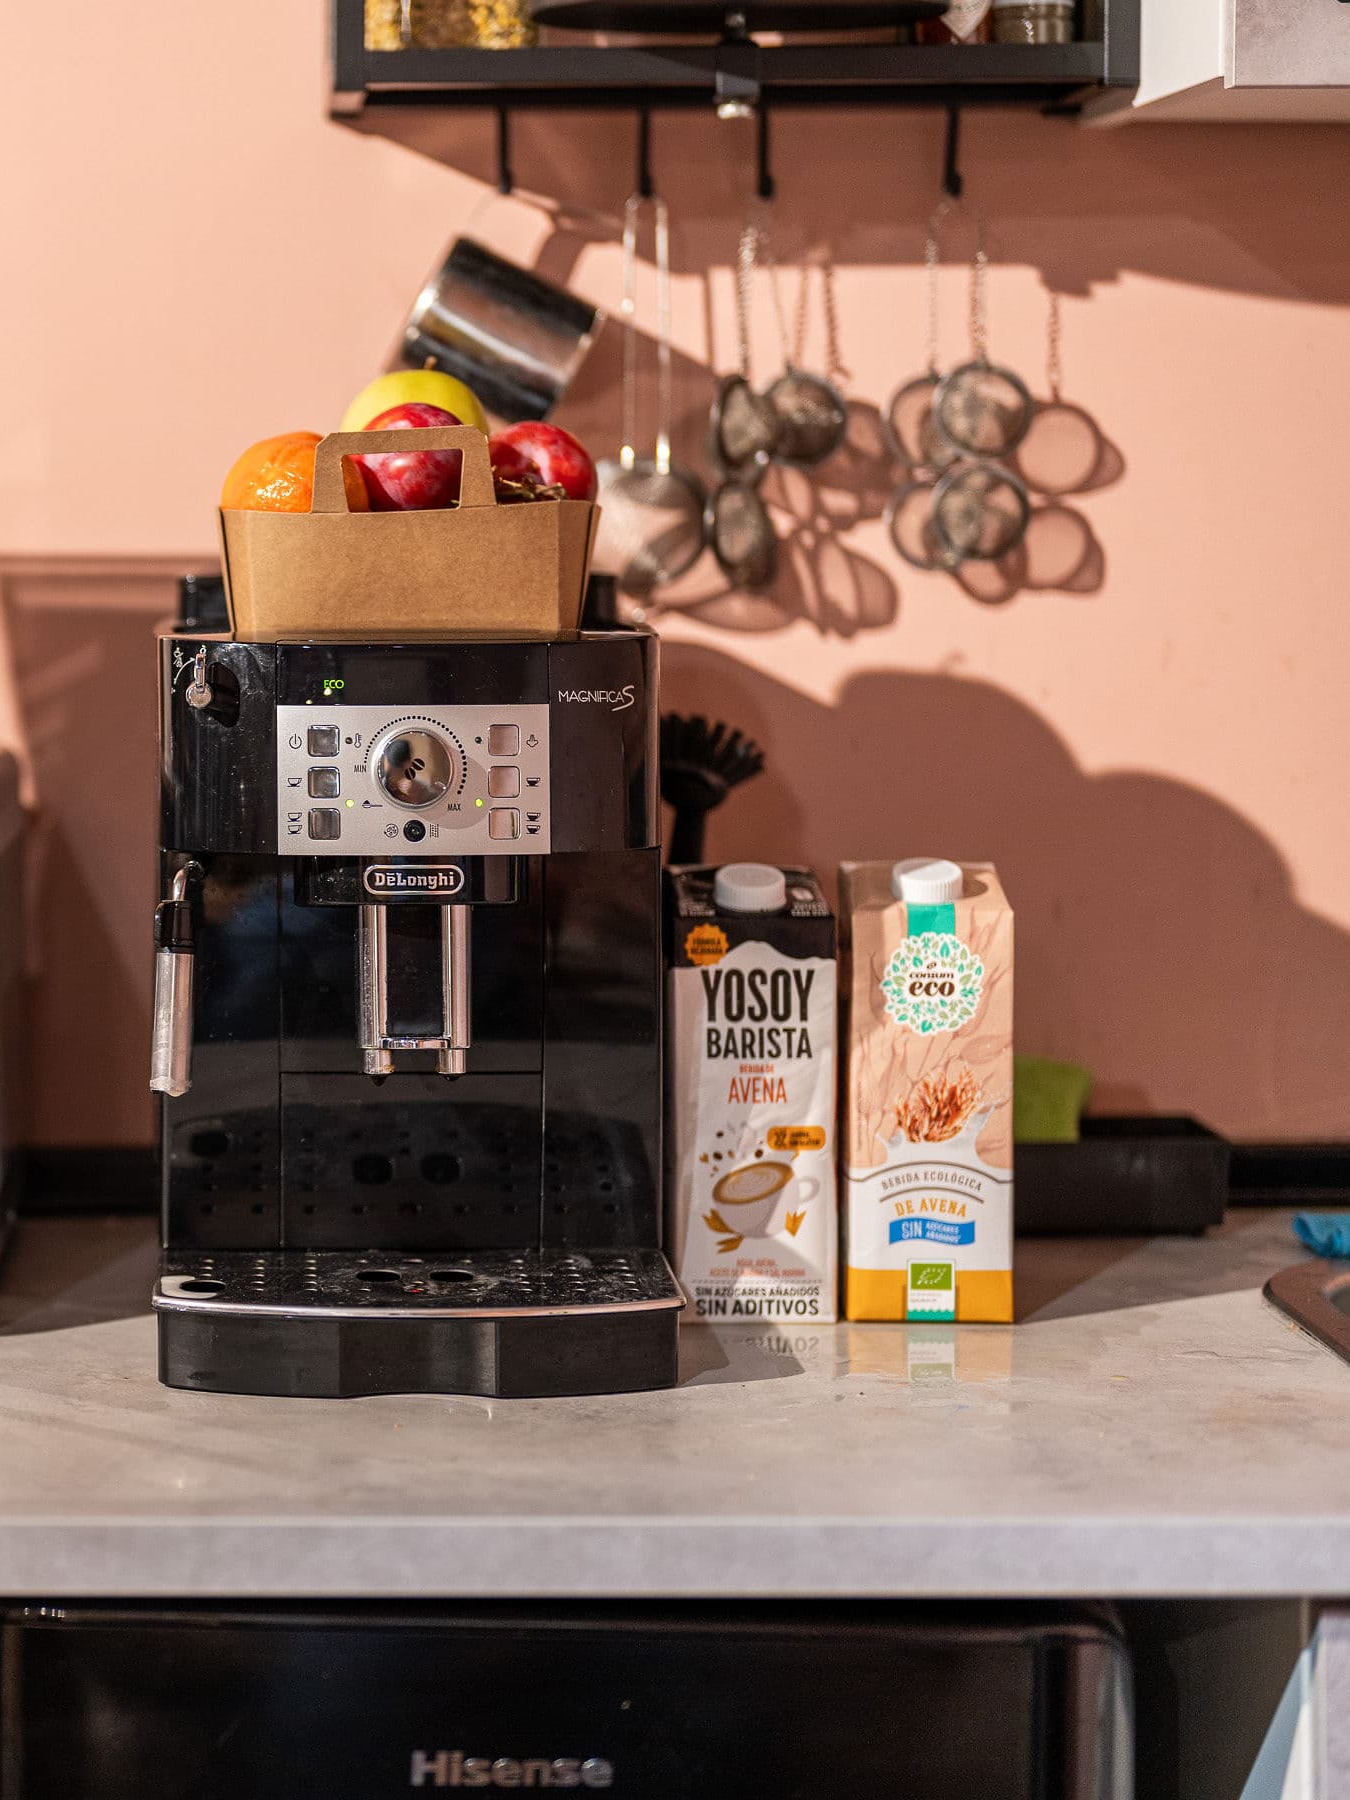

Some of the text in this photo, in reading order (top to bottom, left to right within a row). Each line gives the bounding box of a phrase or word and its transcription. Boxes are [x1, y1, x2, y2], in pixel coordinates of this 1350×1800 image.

[323, 679, 345, 689] ECO
[353, 765, 367, 773] MIN
[447, 803, 461, 812] MAX
[701, 968, 815, 1023] YOSOY
[909, 981, 955, 997] eco
[706, 1027, 813, 1059] BARISTA
[728, 1077, 788, 1104] AVENA
[881, 1171, 982, 1191] BEBIDA ECOLÓGICA
[894, 1198, 967, 1218] DE AVENA
[901, 1221, 923, 1240] SIN
[695, 1286, 713, 1297] SIN
[696, 1299, 820, 1316] SIN ADITIVOS
[410, 1750, 614, 1787] Hisense
